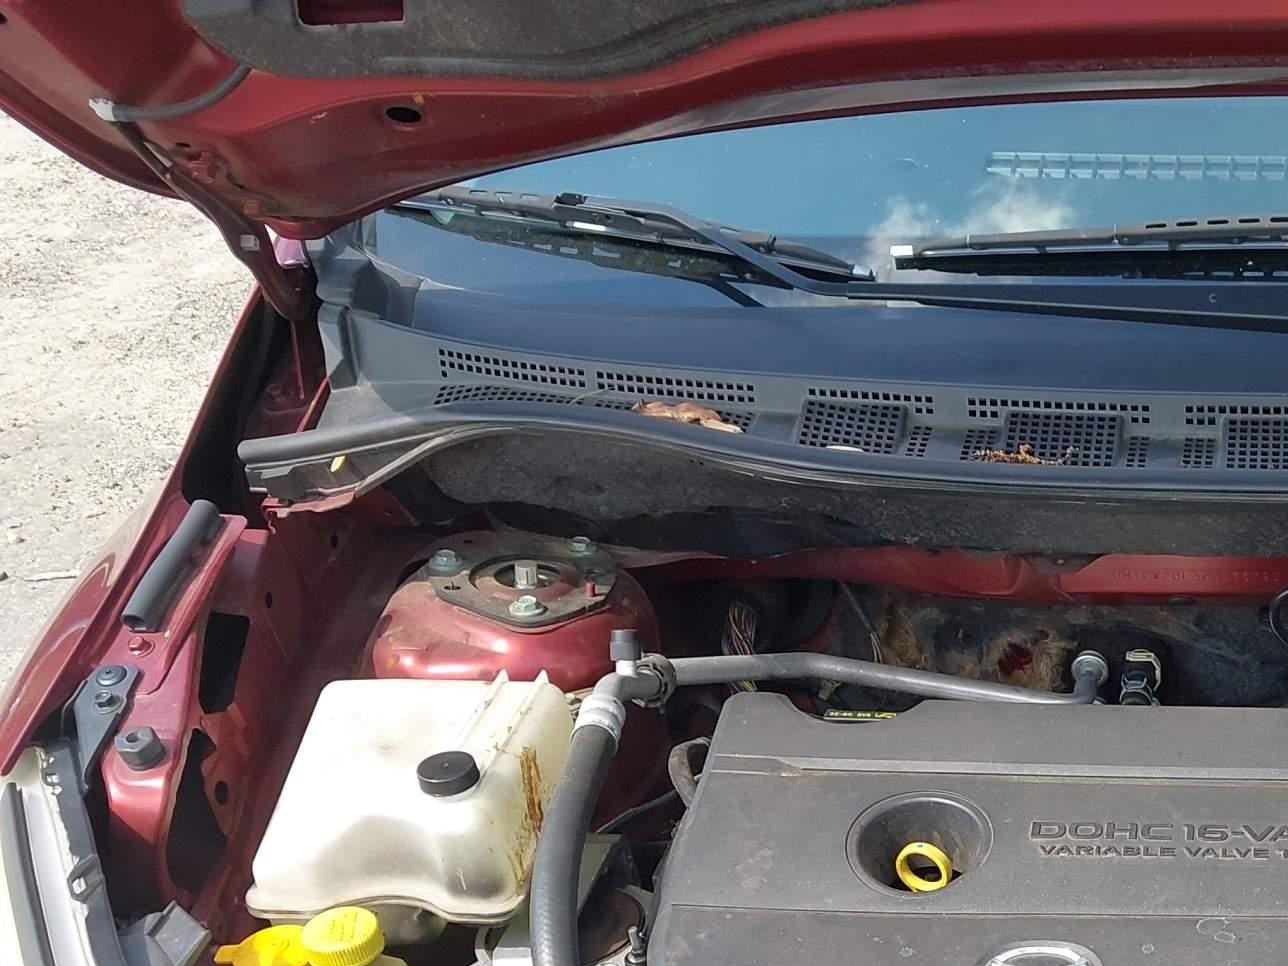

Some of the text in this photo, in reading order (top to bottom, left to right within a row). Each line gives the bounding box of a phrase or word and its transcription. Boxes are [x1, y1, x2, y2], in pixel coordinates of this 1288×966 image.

[1029, 820, 1174, 841] DOHC
[1038, 843, 1177, 859] VARIABLE
[1183, 845, 1271, 860] VALVE
